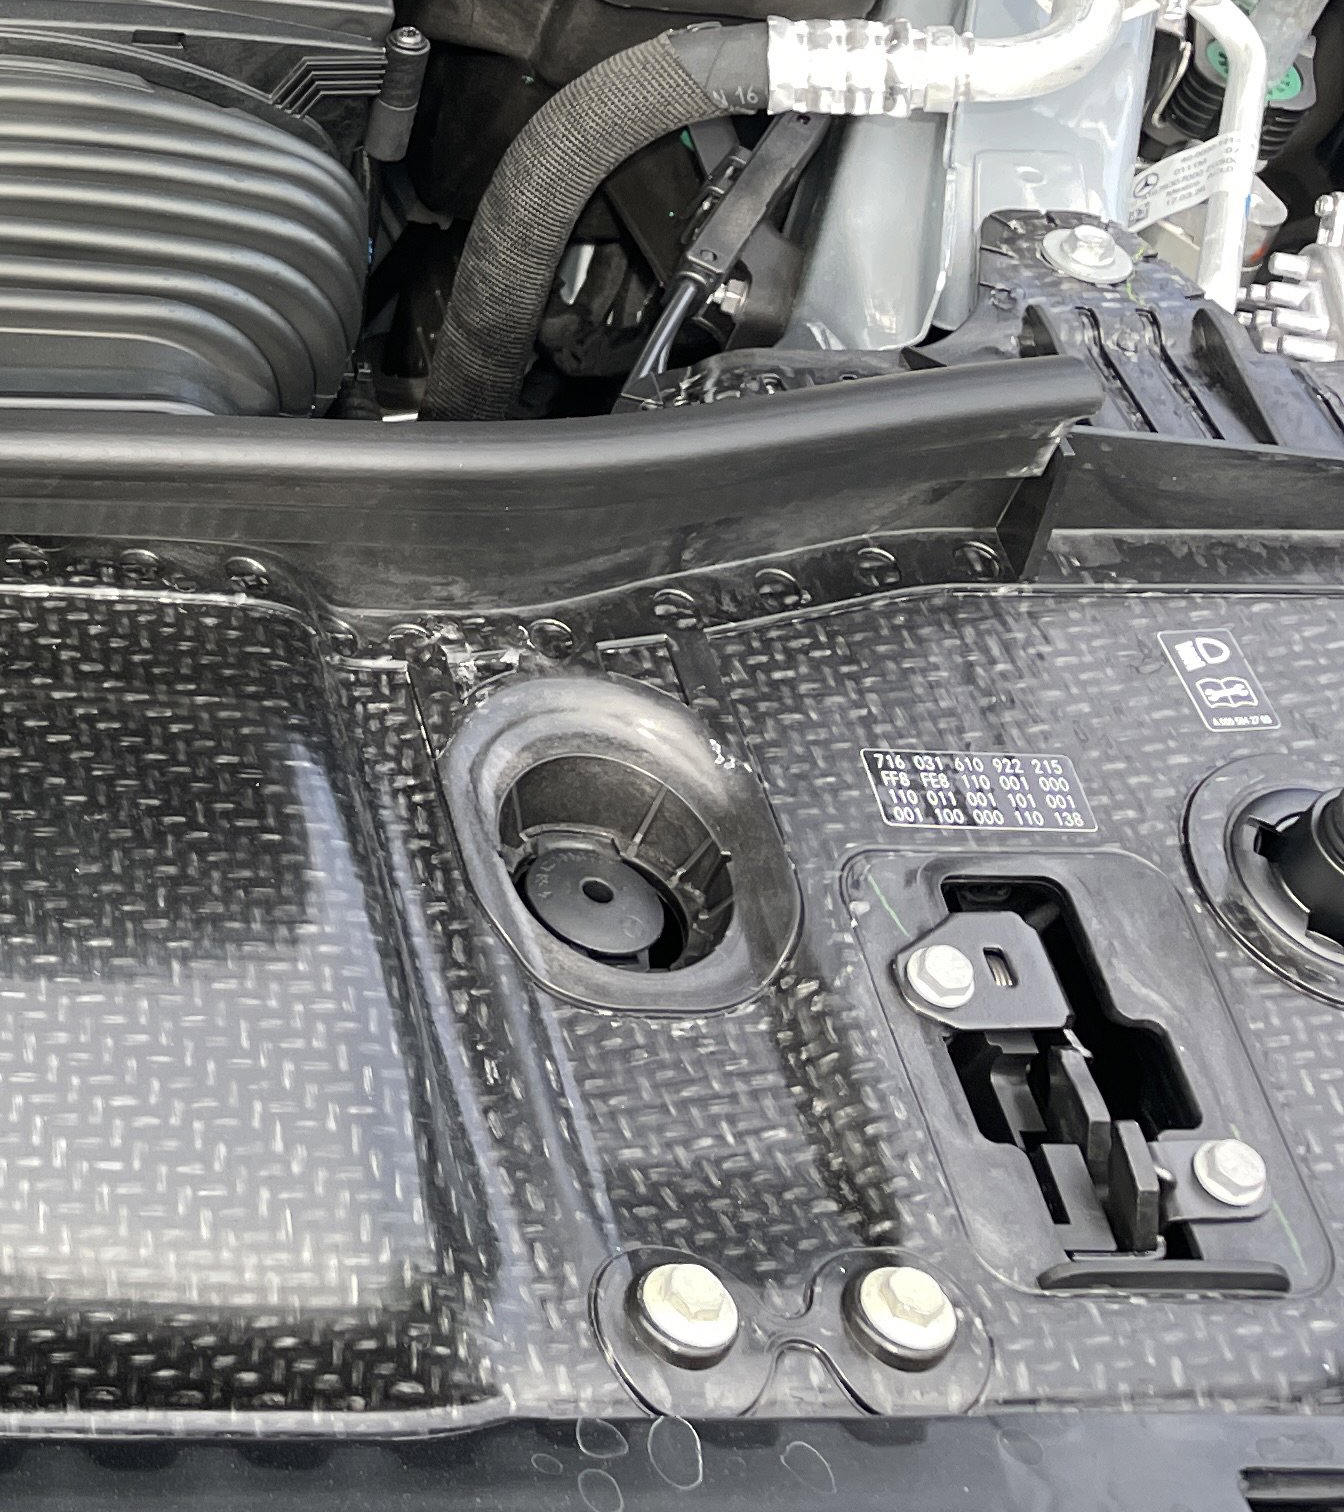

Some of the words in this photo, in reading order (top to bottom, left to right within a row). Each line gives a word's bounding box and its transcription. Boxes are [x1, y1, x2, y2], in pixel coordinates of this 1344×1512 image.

[874, 754, 905, 769] 716
[914, 756, 943, 770] 031
[955, 757, 983, 772] 610
[993, 758, 1024, 773] 922
[1032, 759, 1062, 774] 215
[881, 771, 910, 787] FF8
[920, 772, 949, 788] FE8
[962, 774, 990, 790] 110
[999, 775, 1029, 790] 001
[1039, 777, 1069, 791] 000
[889, 789, 918, 805] 110
[927, 791, 956, 806] 011
[967, 792, 997, 807] 001
[1008, 793, 1037, 808] 101
[1046, 795, 1075, 809] 001
[893, 806, 923, 822] 001
[934, 808, 964, 823] 100
[973, 810, 1004, 825] 000
[1014, 811, 1044, 826] 110
[1054, 812, 1084, 827] 138
